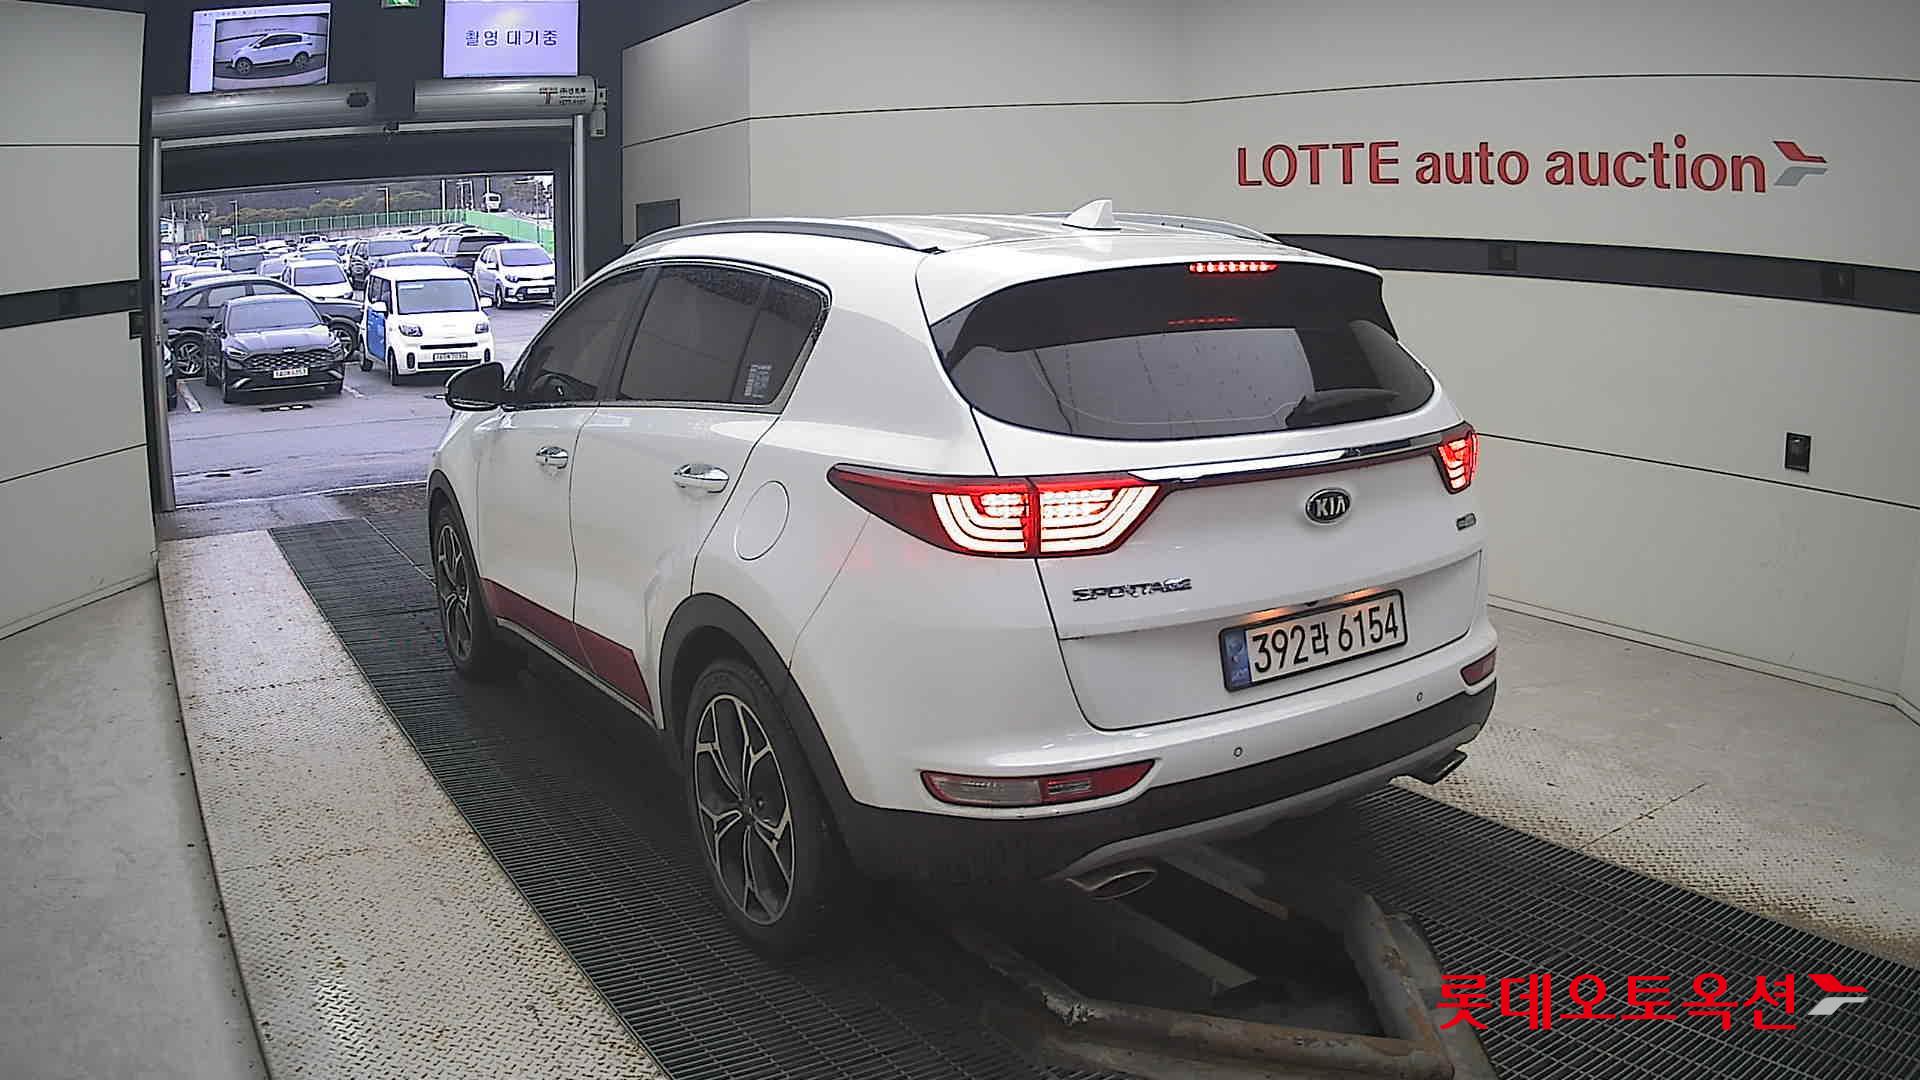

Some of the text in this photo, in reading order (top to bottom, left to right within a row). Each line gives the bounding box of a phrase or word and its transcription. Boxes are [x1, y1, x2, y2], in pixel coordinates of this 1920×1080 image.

[465, 30, 558, 47] 촬영 대기중
[1237, 134, 1766, 193] LOTTE auto auction
[1315, 495, 1346, 517] KIA
[1072, 578, 1192, 602] SPORTAGE
[1252, 602, 1399, 673] 392라 6154
